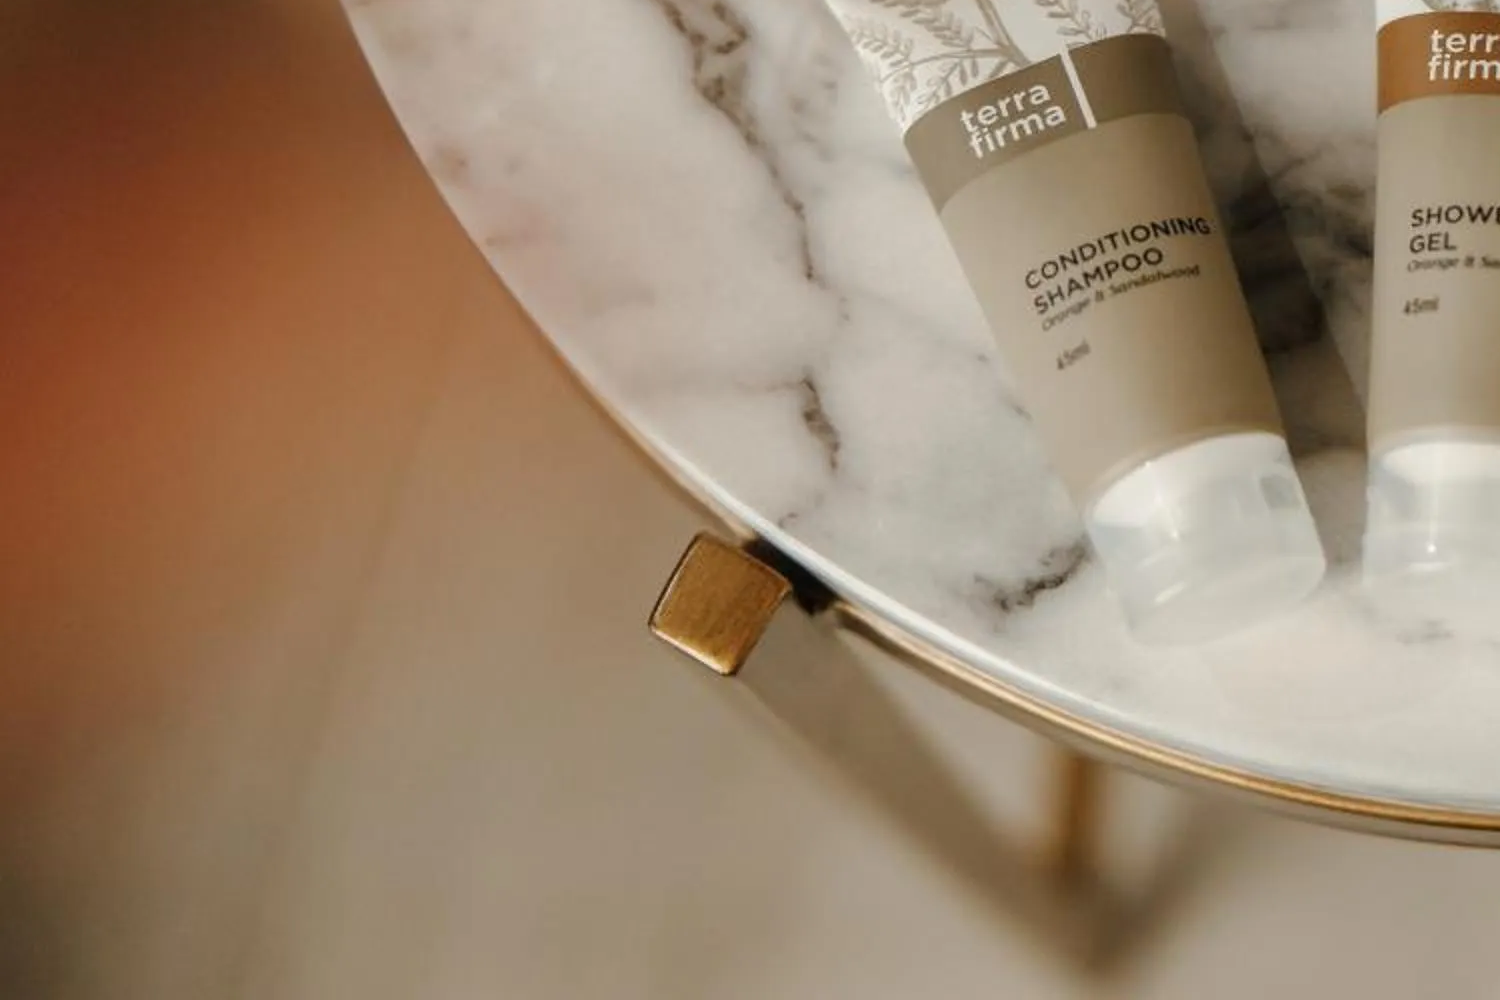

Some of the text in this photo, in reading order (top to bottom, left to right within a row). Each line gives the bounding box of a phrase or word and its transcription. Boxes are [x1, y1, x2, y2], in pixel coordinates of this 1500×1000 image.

[960, 83, 1052, 133] terra
[968, 104, 1067, 159] firma
[1025, 216, 1212, 290] CONDITIONING
[1409, 233, 1457, 254] GEL
[1033, 247, 1165, 315] SHAMPOO
